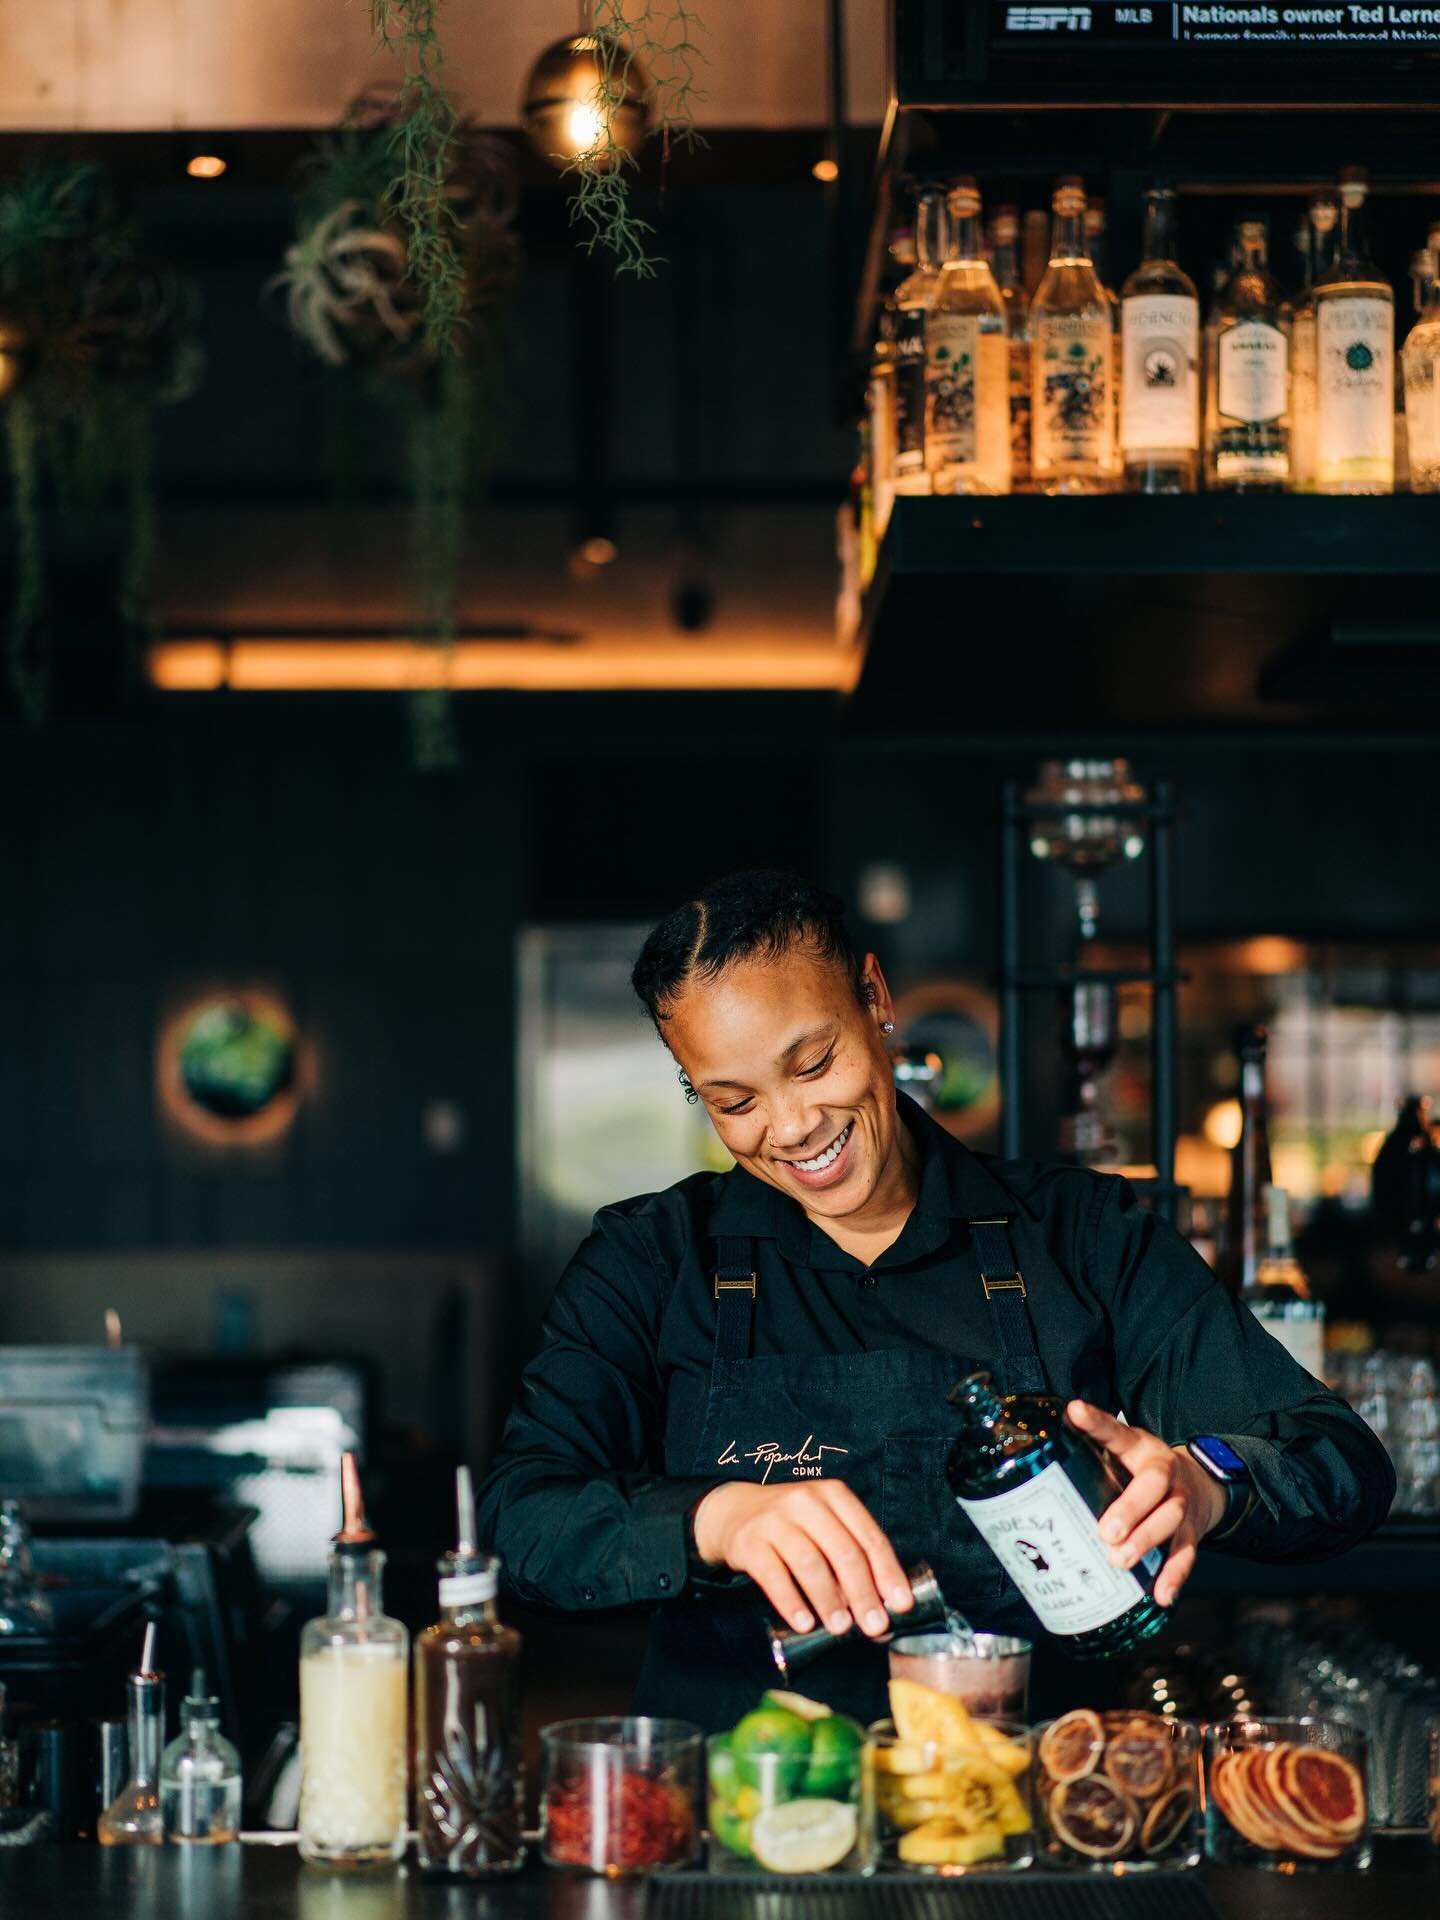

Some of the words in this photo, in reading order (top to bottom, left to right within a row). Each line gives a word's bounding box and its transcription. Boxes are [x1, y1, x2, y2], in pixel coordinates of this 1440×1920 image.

[1005, 6, 1092, 31] ESPN
[1114, 8, 1153, 24] MLB
[1183, 5, 1279, 24] Nationals
[1282, 9, 1344, 24] owner
[1347, 5, 1384, 24] Ted
[717, 1440, 740, 1465] La
[744, 1434, 849, 1485] Popular
[792, 1466, 822, 1477] CDMX
[1034, 1577, 1066, 1595] GIN
